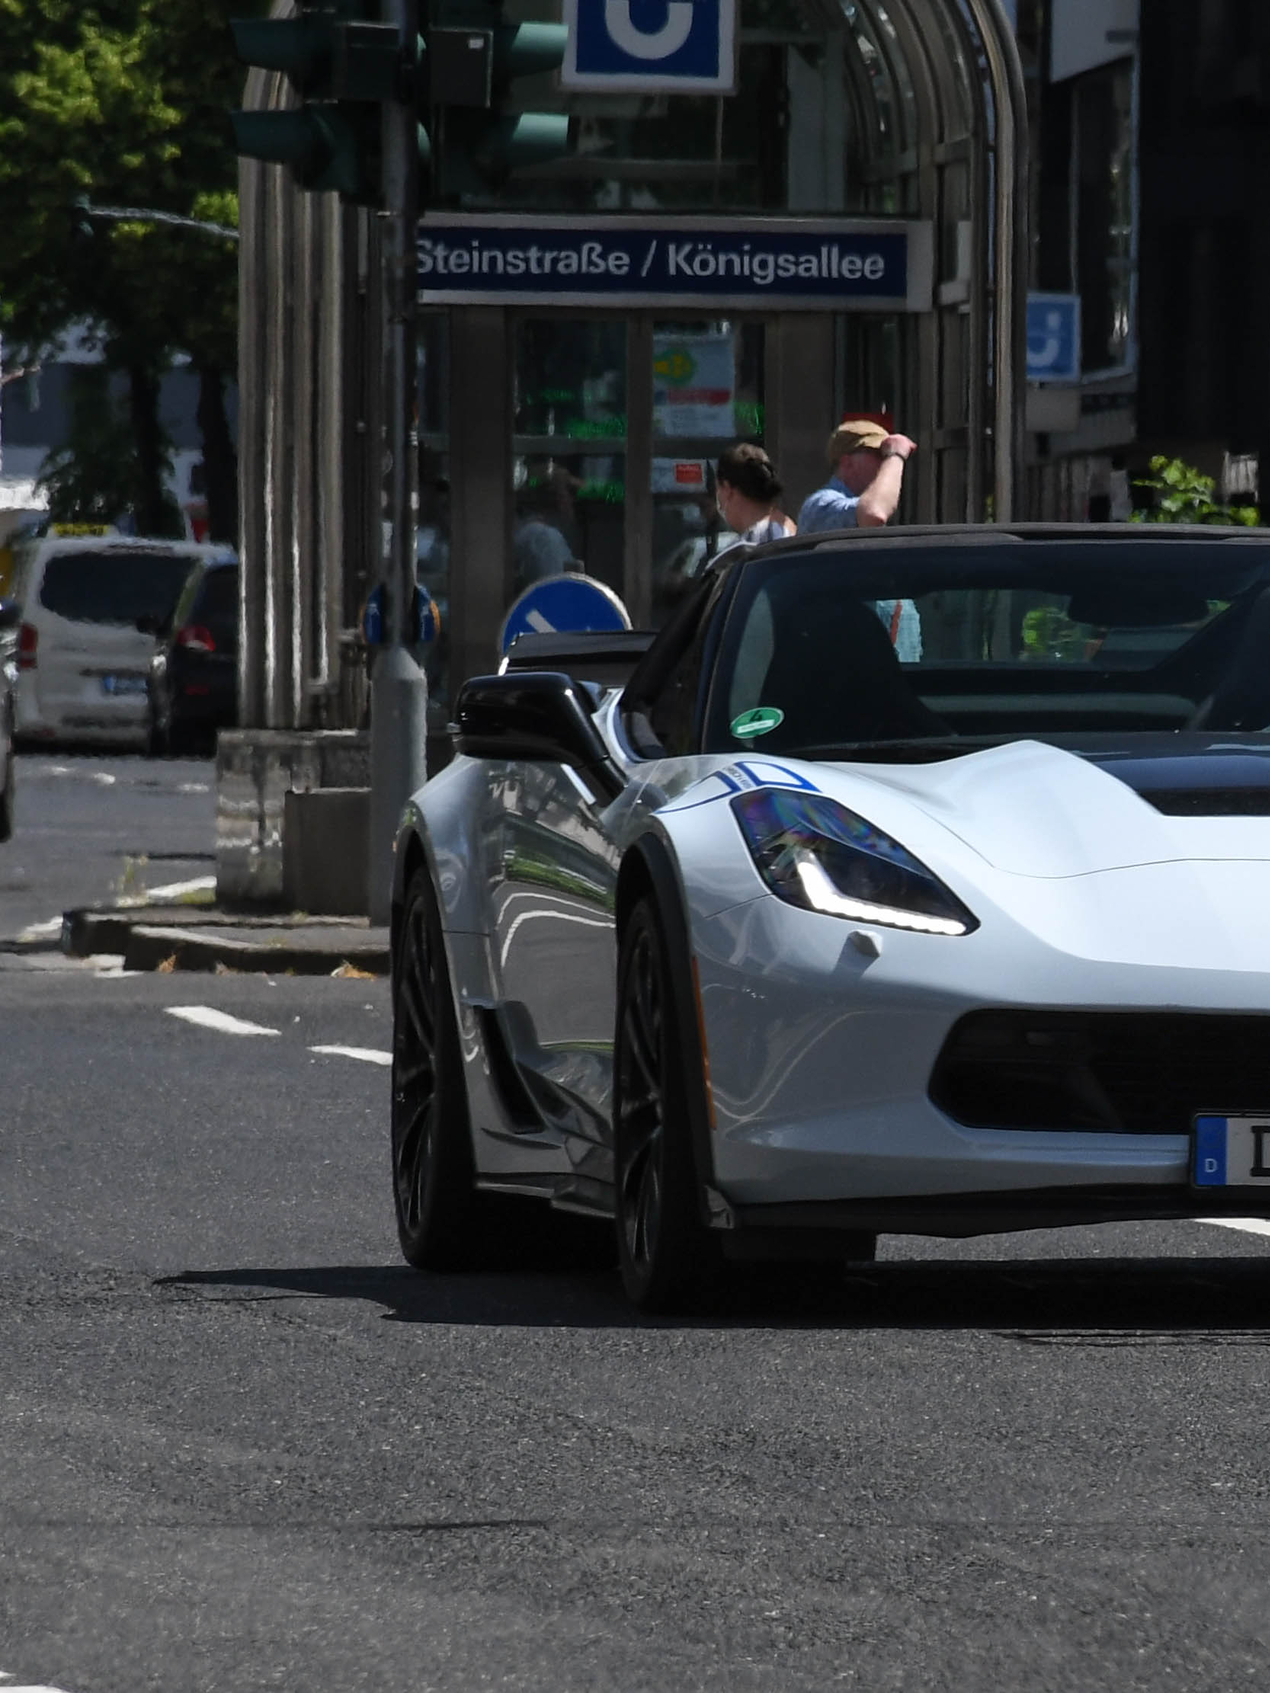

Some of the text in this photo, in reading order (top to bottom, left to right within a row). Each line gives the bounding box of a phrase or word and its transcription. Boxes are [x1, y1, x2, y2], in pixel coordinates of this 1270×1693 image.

[417, 239, 885, 285] Steinstraße / Königsallee
[1204, 1158, 1218, 1173] D
